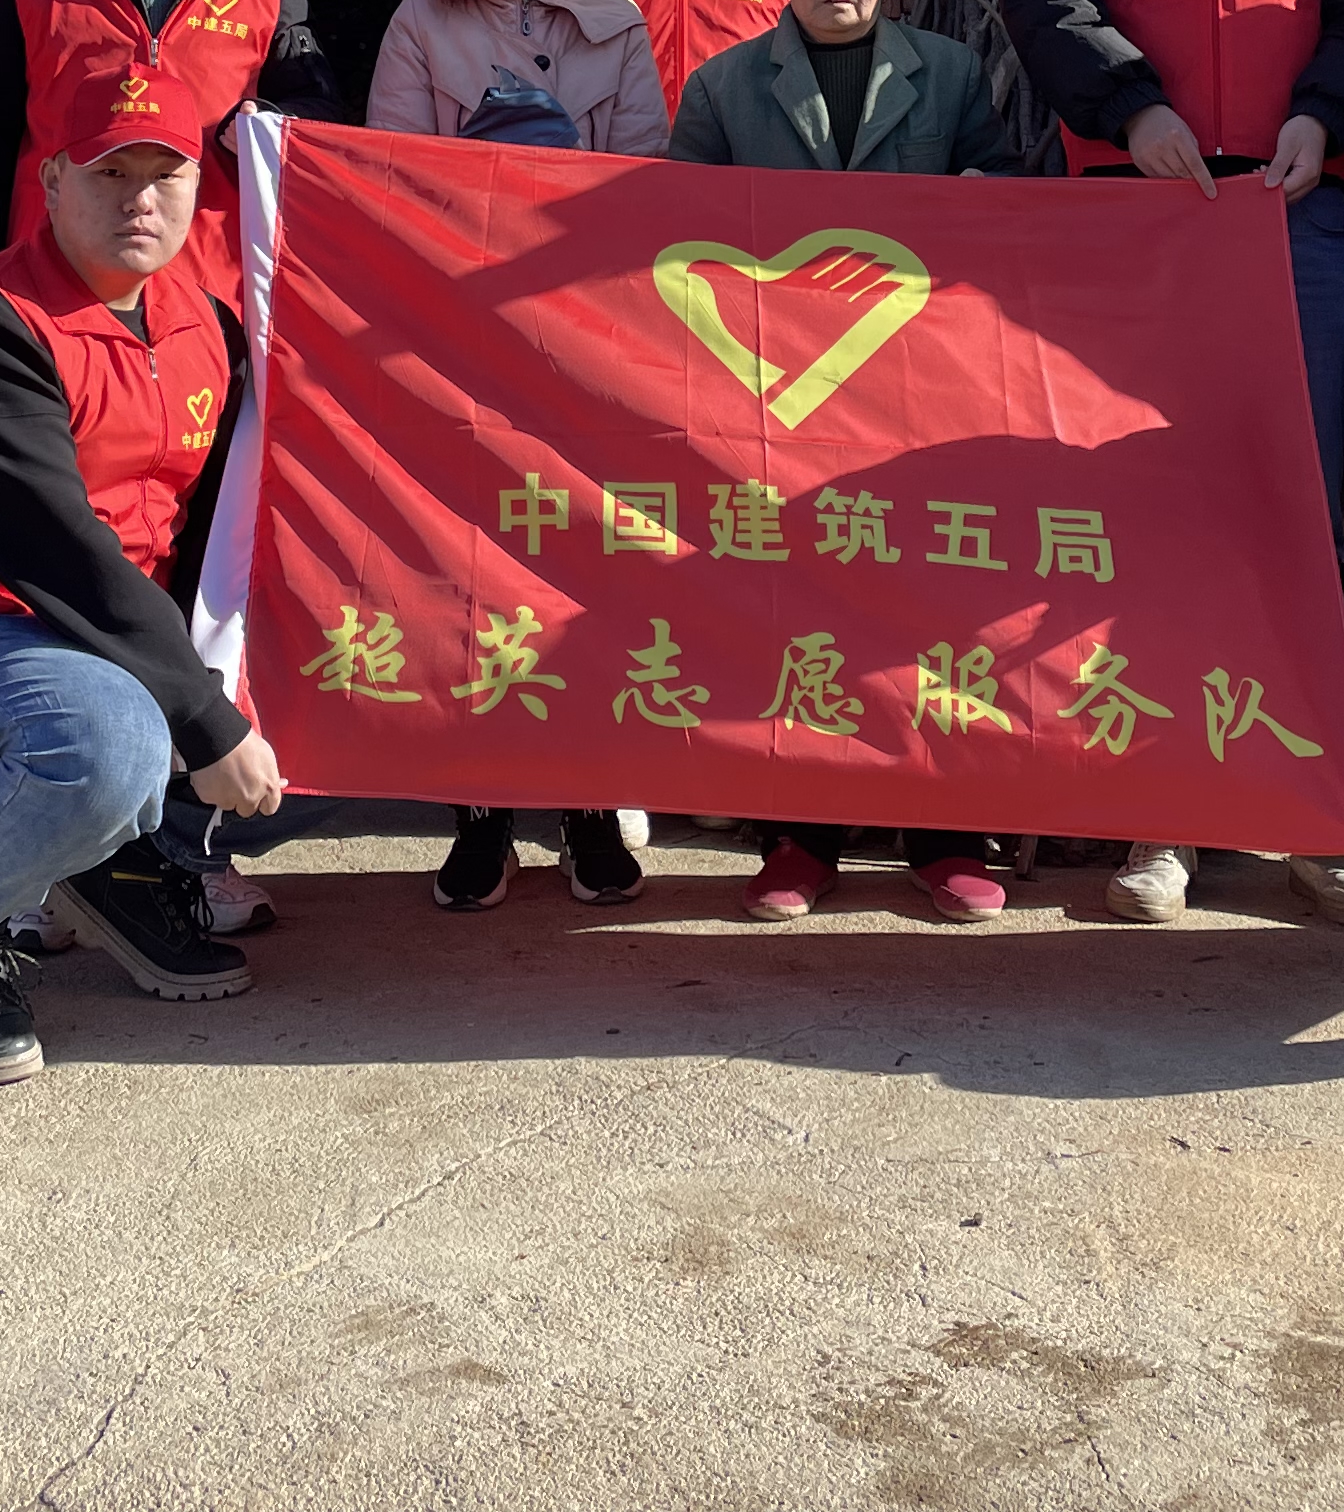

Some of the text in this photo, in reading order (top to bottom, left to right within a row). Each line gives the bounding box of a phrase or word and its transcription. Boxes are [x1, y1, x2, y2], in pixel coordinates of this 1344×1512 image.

[187, 15, 249, 40] 中建五局
[498, 471, 1116, 584] 中国建筑五局
[298, 603, 1325, 764] 超英志愿服务队
